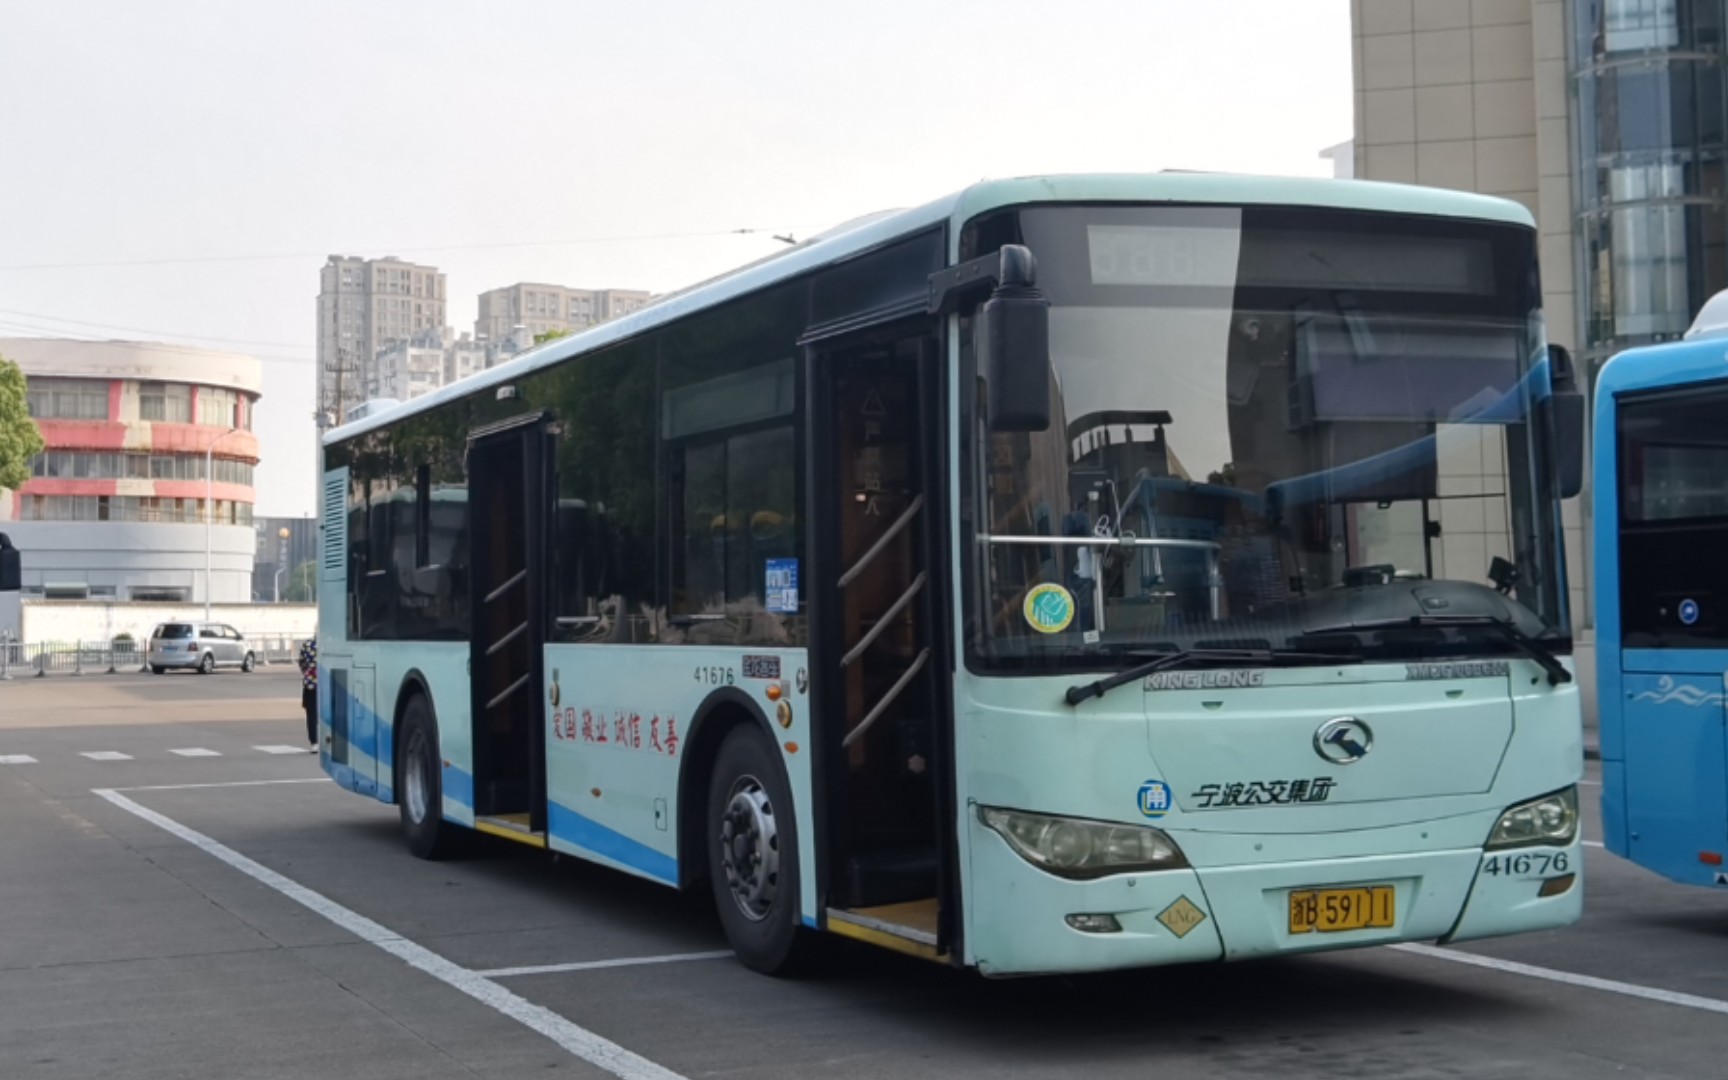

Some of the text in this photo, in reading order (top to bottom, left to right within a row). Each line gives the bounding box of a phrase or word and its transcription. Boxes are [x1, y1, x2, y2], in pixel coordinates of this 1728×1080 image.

[693, 665, 734, 685] 41676
[614, 710, 642, 748] 诚信
[649, 714, 679, 756] 友善
[1190, 775, 1338, 808] 宁波公交集团
[1483, 851, 1568, 876] 41676
